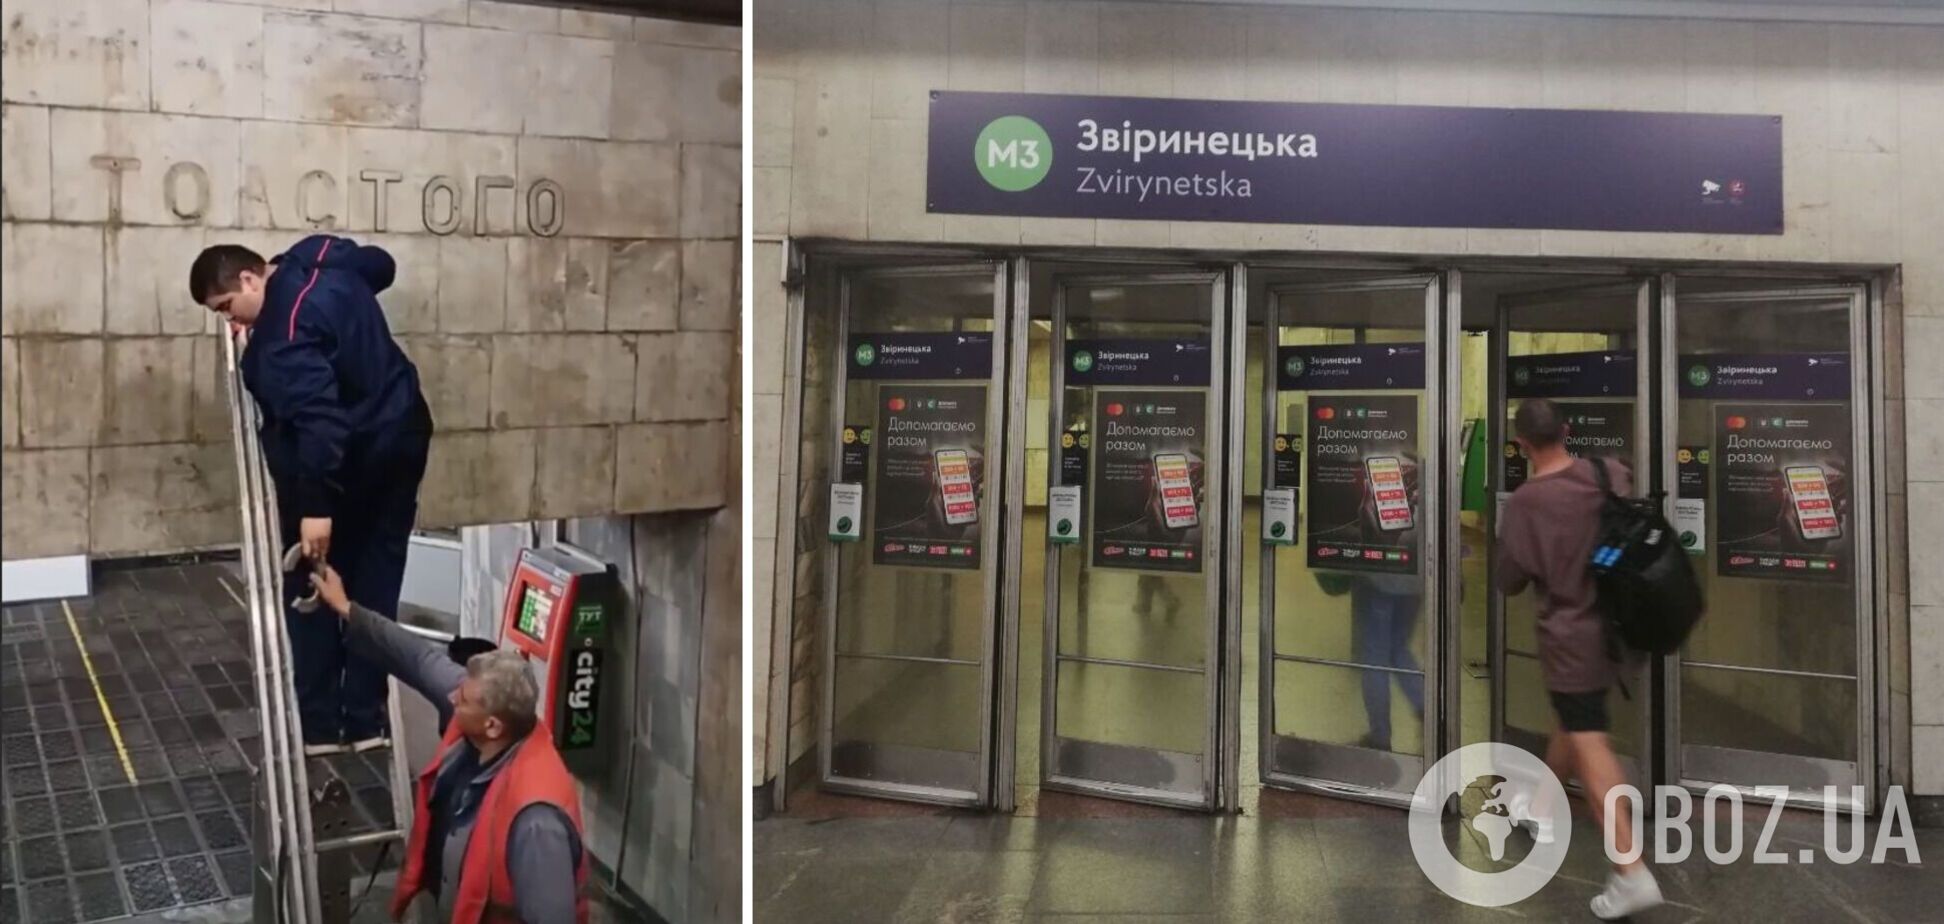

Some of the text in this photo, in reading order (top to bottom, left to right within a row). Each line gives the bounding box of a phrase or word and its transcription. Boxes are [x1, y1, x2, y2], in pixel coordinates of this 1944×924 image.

[1077, 119, 1318, 162] Звіринецька
[987, 139, 1040, 168] M3
[1076, 167, 1252, 202] Zvirynetska
[880, 345, 931, 354] Звіринецька
[1098, 351, 1149, 361] Звіринецька
[1716, 366, 1777, 376] Звіринецька
[888, 416, 976, 432] Допомагаємо
[1106, 421, 1195, 436] Допомагаємо
[1317, 426, 1408, 440] Допомагаємо
[888, 437, 927, 449] разом
[1106, 441, 1146, 453] разом
[1562, 436, 1624, 448] омагаємо
[1727, 434, 1832, 449] Допомагаємо
[1317, 444, 1358, 456] разом
[1727, 452, 1774, 465] разом
[568, 652, 598, 745] city24
